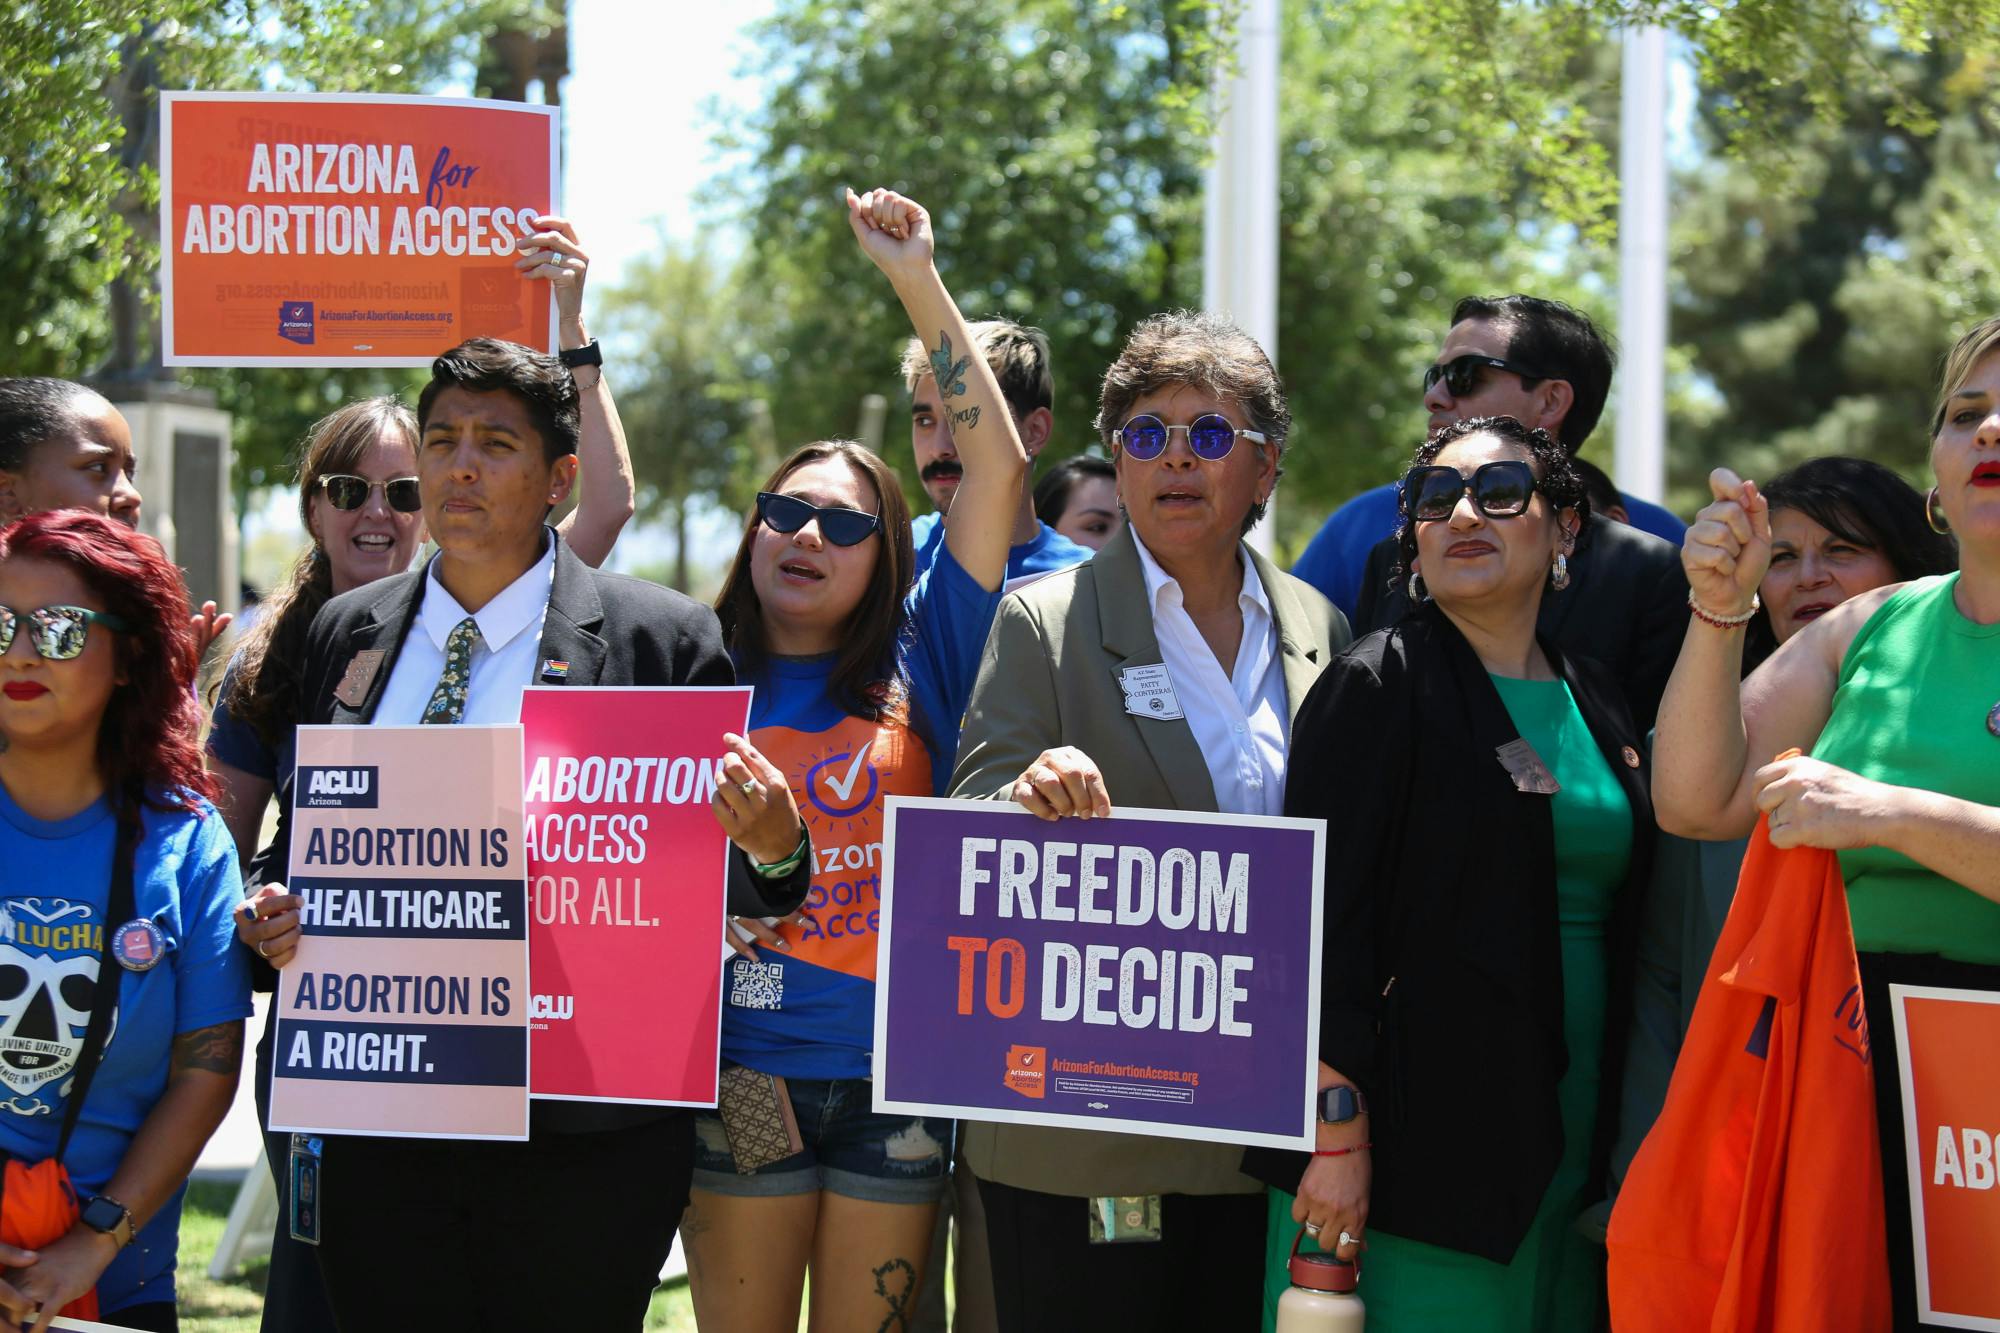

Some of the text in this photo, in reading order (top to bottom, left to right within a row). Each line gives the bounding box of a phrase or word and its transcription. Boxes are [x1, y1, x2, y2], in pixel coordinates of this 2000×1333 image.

[248, 143, 420, 194] ARIZONA
[426, 146, 481, 210] for
[183, 204, 379, 256] ABORTION
[320, 310, 452, 324] ArizonaForAbortionAccess.org
[1133, 687, 1171, 698] CONTRERAS
[1140, 680, 1160, 688] PATTY
[308, 770, 369, 795] ACLU
[525, 756, 725, 805] ABORTION
[308, 797, 342, 806] Arizona
[305, 827, 508, 868] ABORTION IS
[525, 813, 648, 864] ACCESS
[959, 836, 1250, 934] FREEDOM
[300, 888, 511, 930] HEALTHCARE.
[590, 877, 660, 927] ALL.
[18, 921, 103, 952] LUCHA
[802, 909, 880, 941] Acce
[293, 972, 511, 1017] ABORTION IS
[947, 935, 1254, 1037] TO DECIDE
[530, 1023, 549, 1031] zona
[20, 1055, 40, 1065] FOR
[36, 1041, 72, 1057] UNITED
[287, 1030, 434, 1073] A RIGHT.
[33, 1062, 72, 1083] ARIZONA
[1010, 1069, 1038, 1077] Arizona
[1052, 1057, 1199, 1087] ArizonaForAbortionAccess.org
[1934, 1125, 2000, 1190] AB
